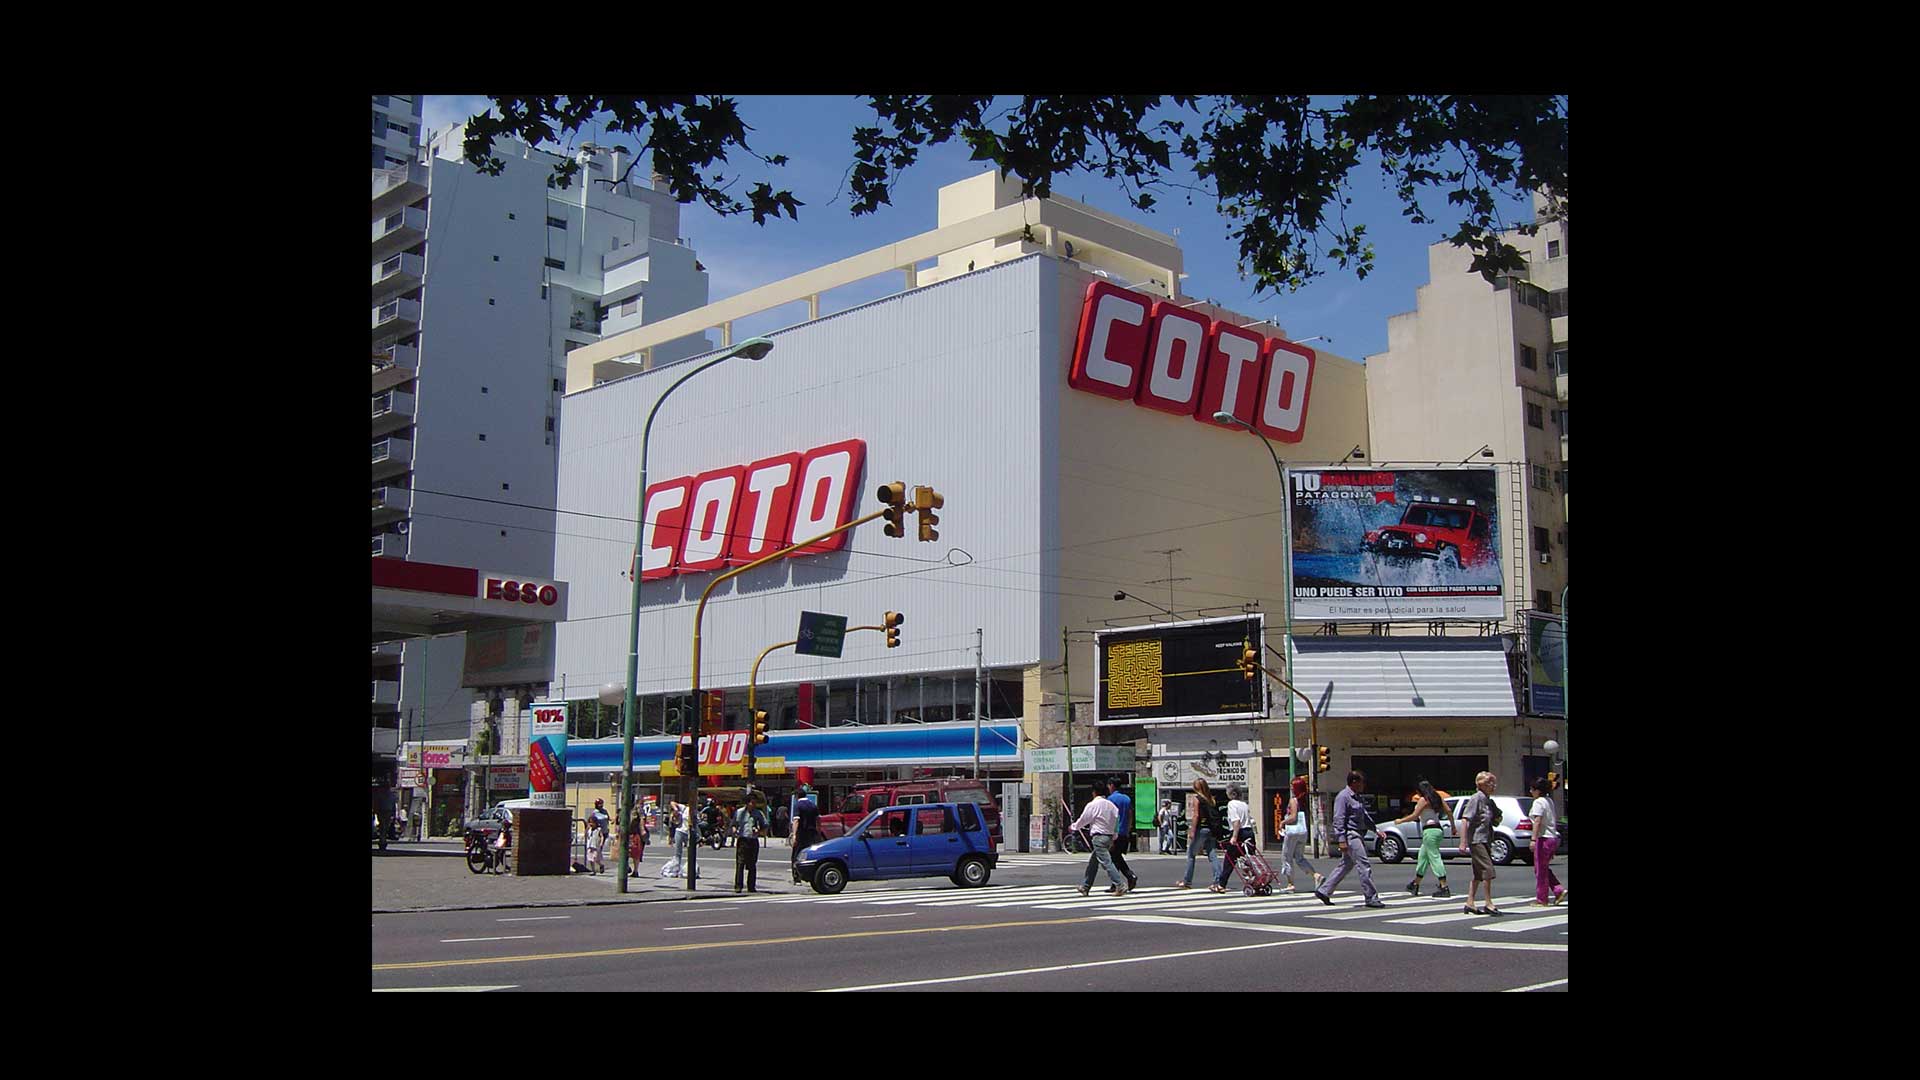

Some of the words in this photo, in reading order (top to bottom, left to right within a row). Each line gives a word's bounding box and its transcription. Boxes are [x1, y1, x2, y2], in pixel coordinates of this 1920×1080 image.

[1084, 292, 1304, 433] COTO
[1291, 473, 1320, 491] 10
[1295, 491, 1374, 499] PATAGONIA
[641, 449, 852, 572] COTO
[484, 577, 559, 607] ESSO
[1295, 586, 1318, 597] UNO
[1319, 586, 1355, 597] PUEDE
[1356, 586, 1376, 597] SER
[1377, 586, 1403, 597] TUYO
[1329, 606, 1337, 614] El
[1338, 606, 1362, 614] fumar
[1374, 606, 1414, 616] perjudicial
[1416, 608, 1434, 616] para
[1435, 606, 1444, 614] la
[1445, 605, 1466, 613] salud
[534, 709, 565, 723] 10%
[681, 733, 747, 762] OTO
[1217, 760, 1245, 768] CENTRO
